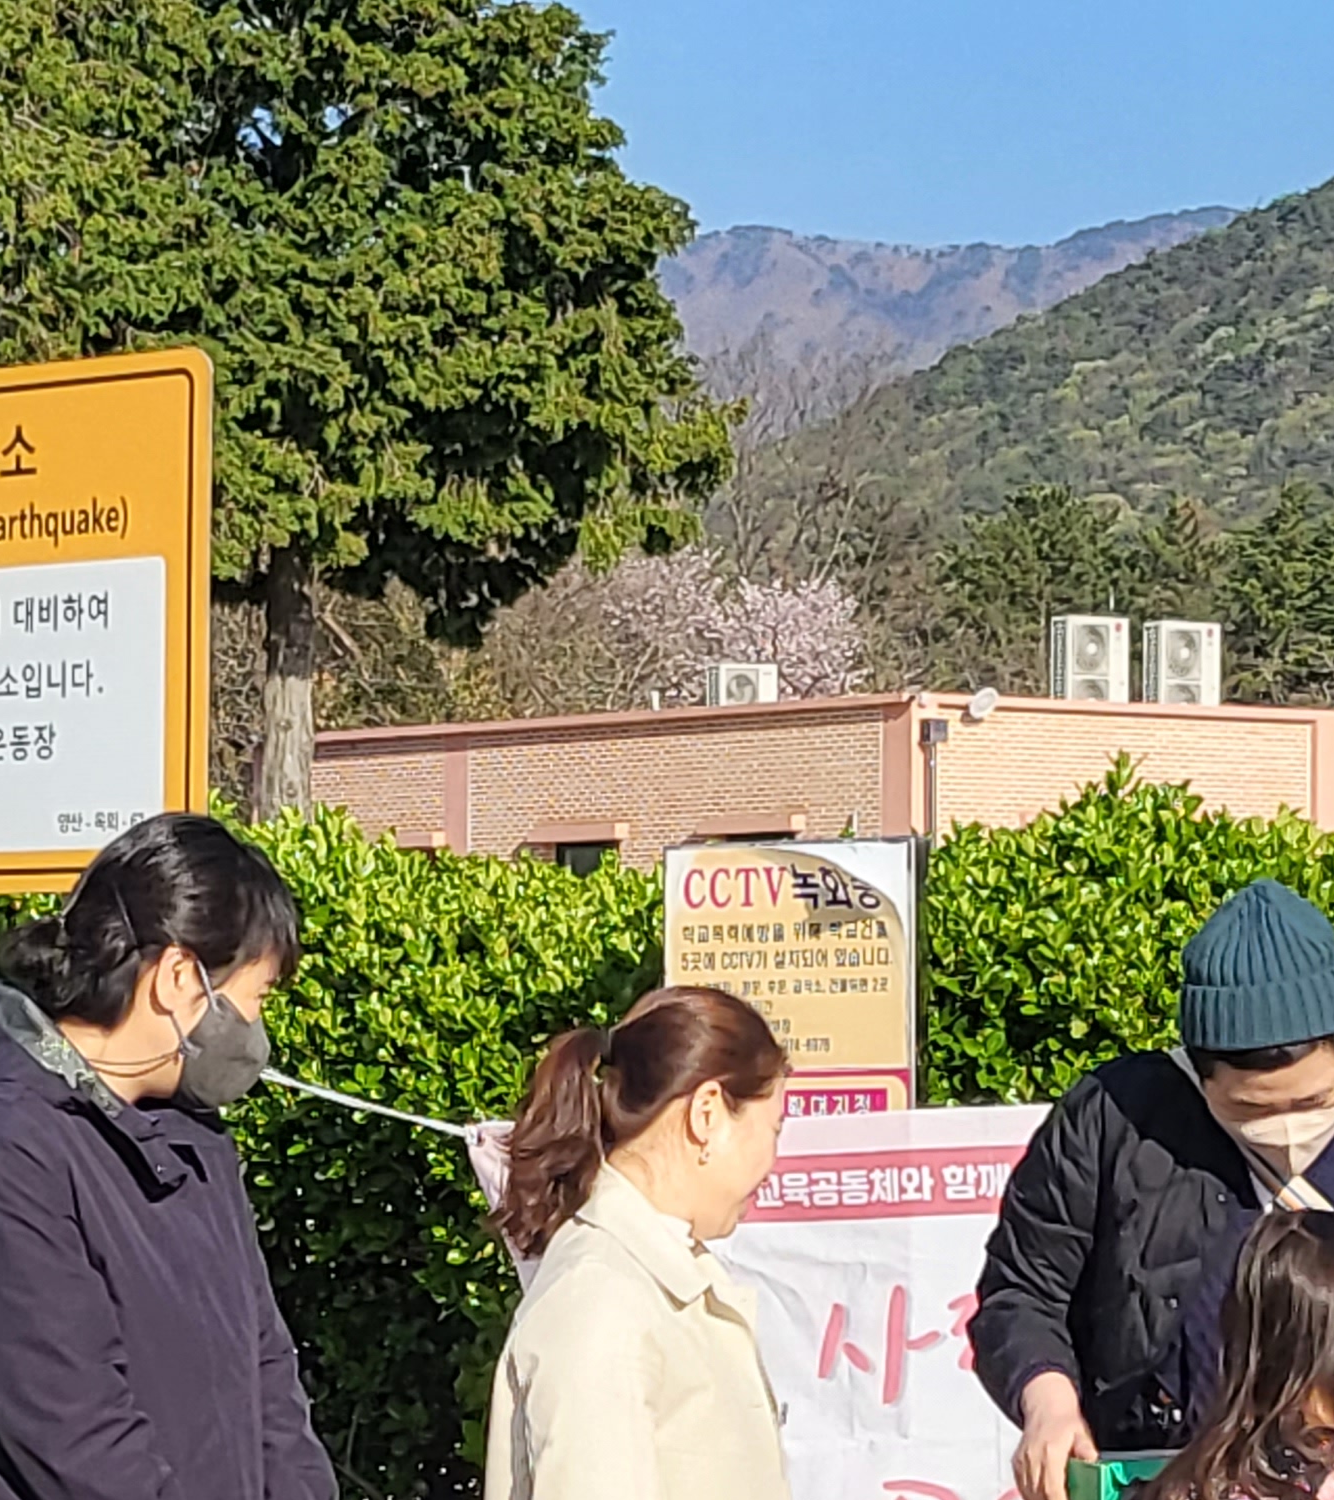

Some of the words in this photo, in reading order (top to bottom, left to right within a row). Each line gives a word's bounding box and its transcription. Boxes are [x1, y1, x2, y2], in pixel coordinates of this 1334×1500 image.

[13, 590, 109, 633] 대비하여
[681, 951, 715, 972] 5곳에
[774, 948, 828, 970] 설치되어
[756, 1165, 934, 1208] 교육공동체와
